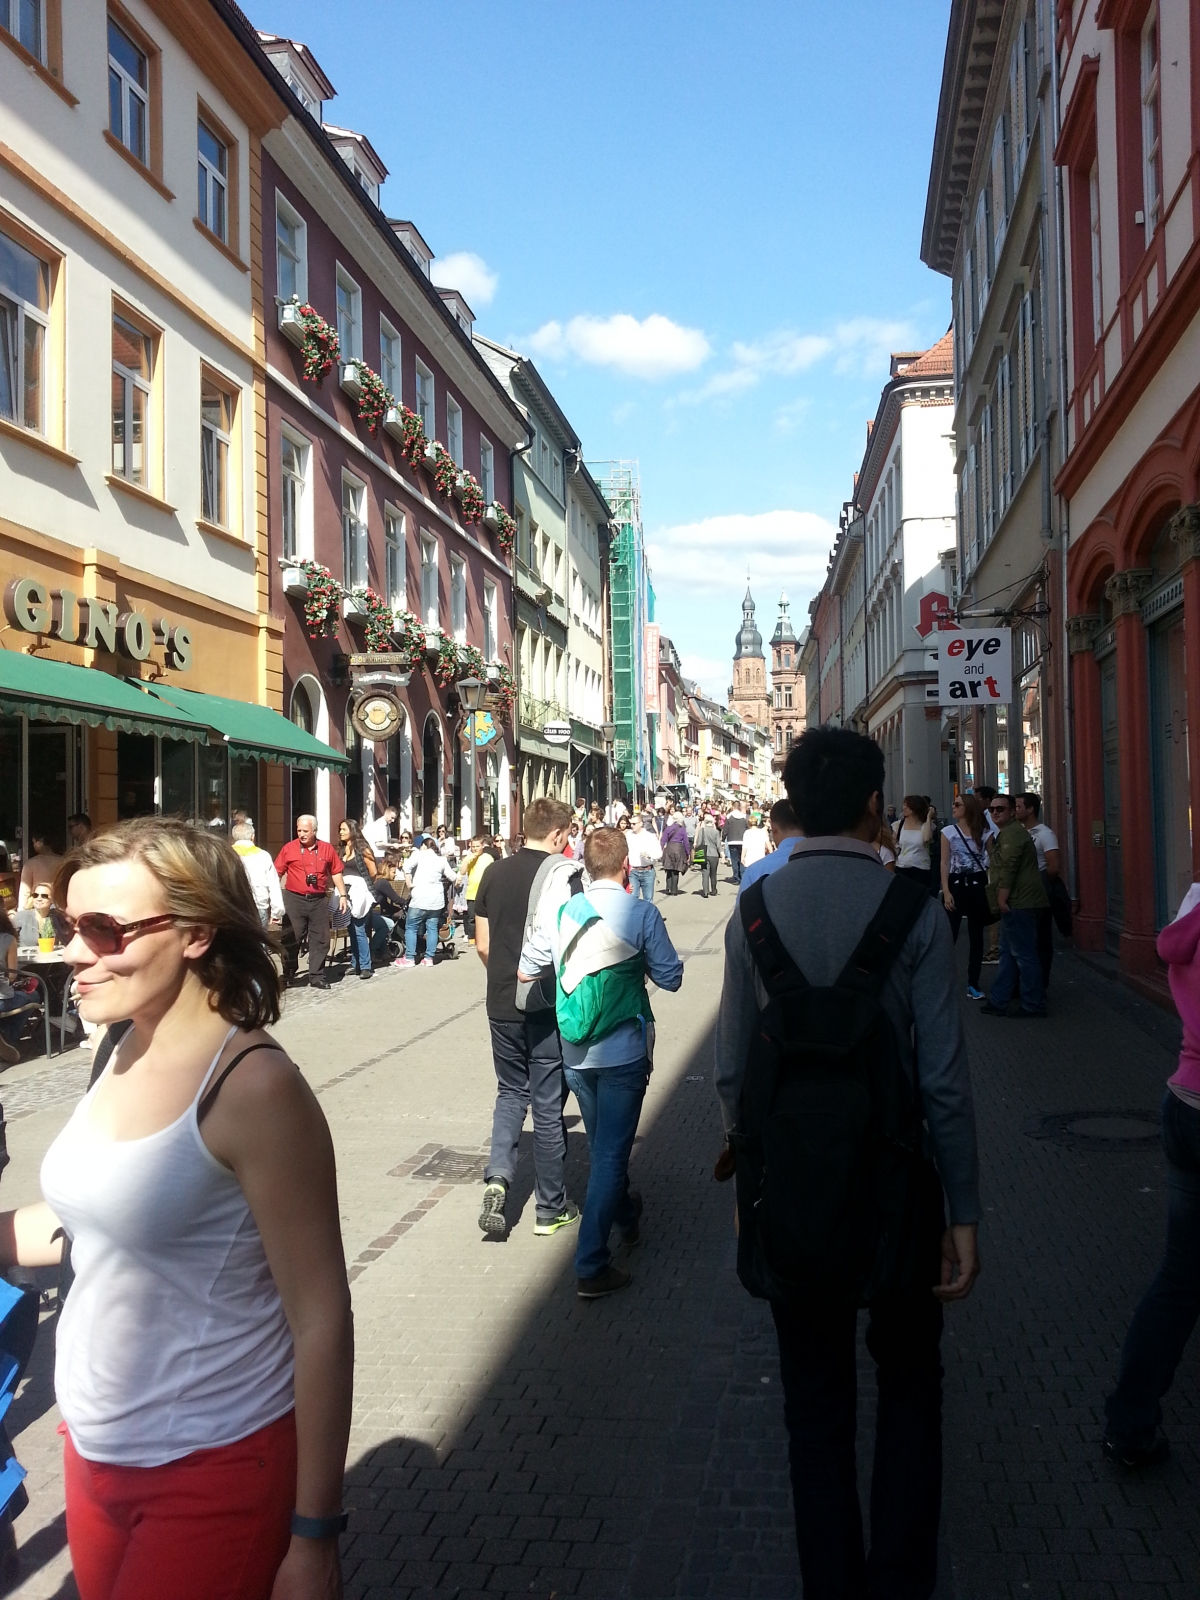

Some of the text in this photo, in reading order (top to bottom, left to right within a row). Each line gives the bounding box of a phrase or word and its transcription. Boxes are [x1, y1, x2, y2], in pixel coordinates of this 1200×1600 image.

[5, 577, 194, 672] GINO'S
[947, 637, 1001, 661] eye
[964, 663, 984, 674] and
[949, 676, 1001, 698] art
